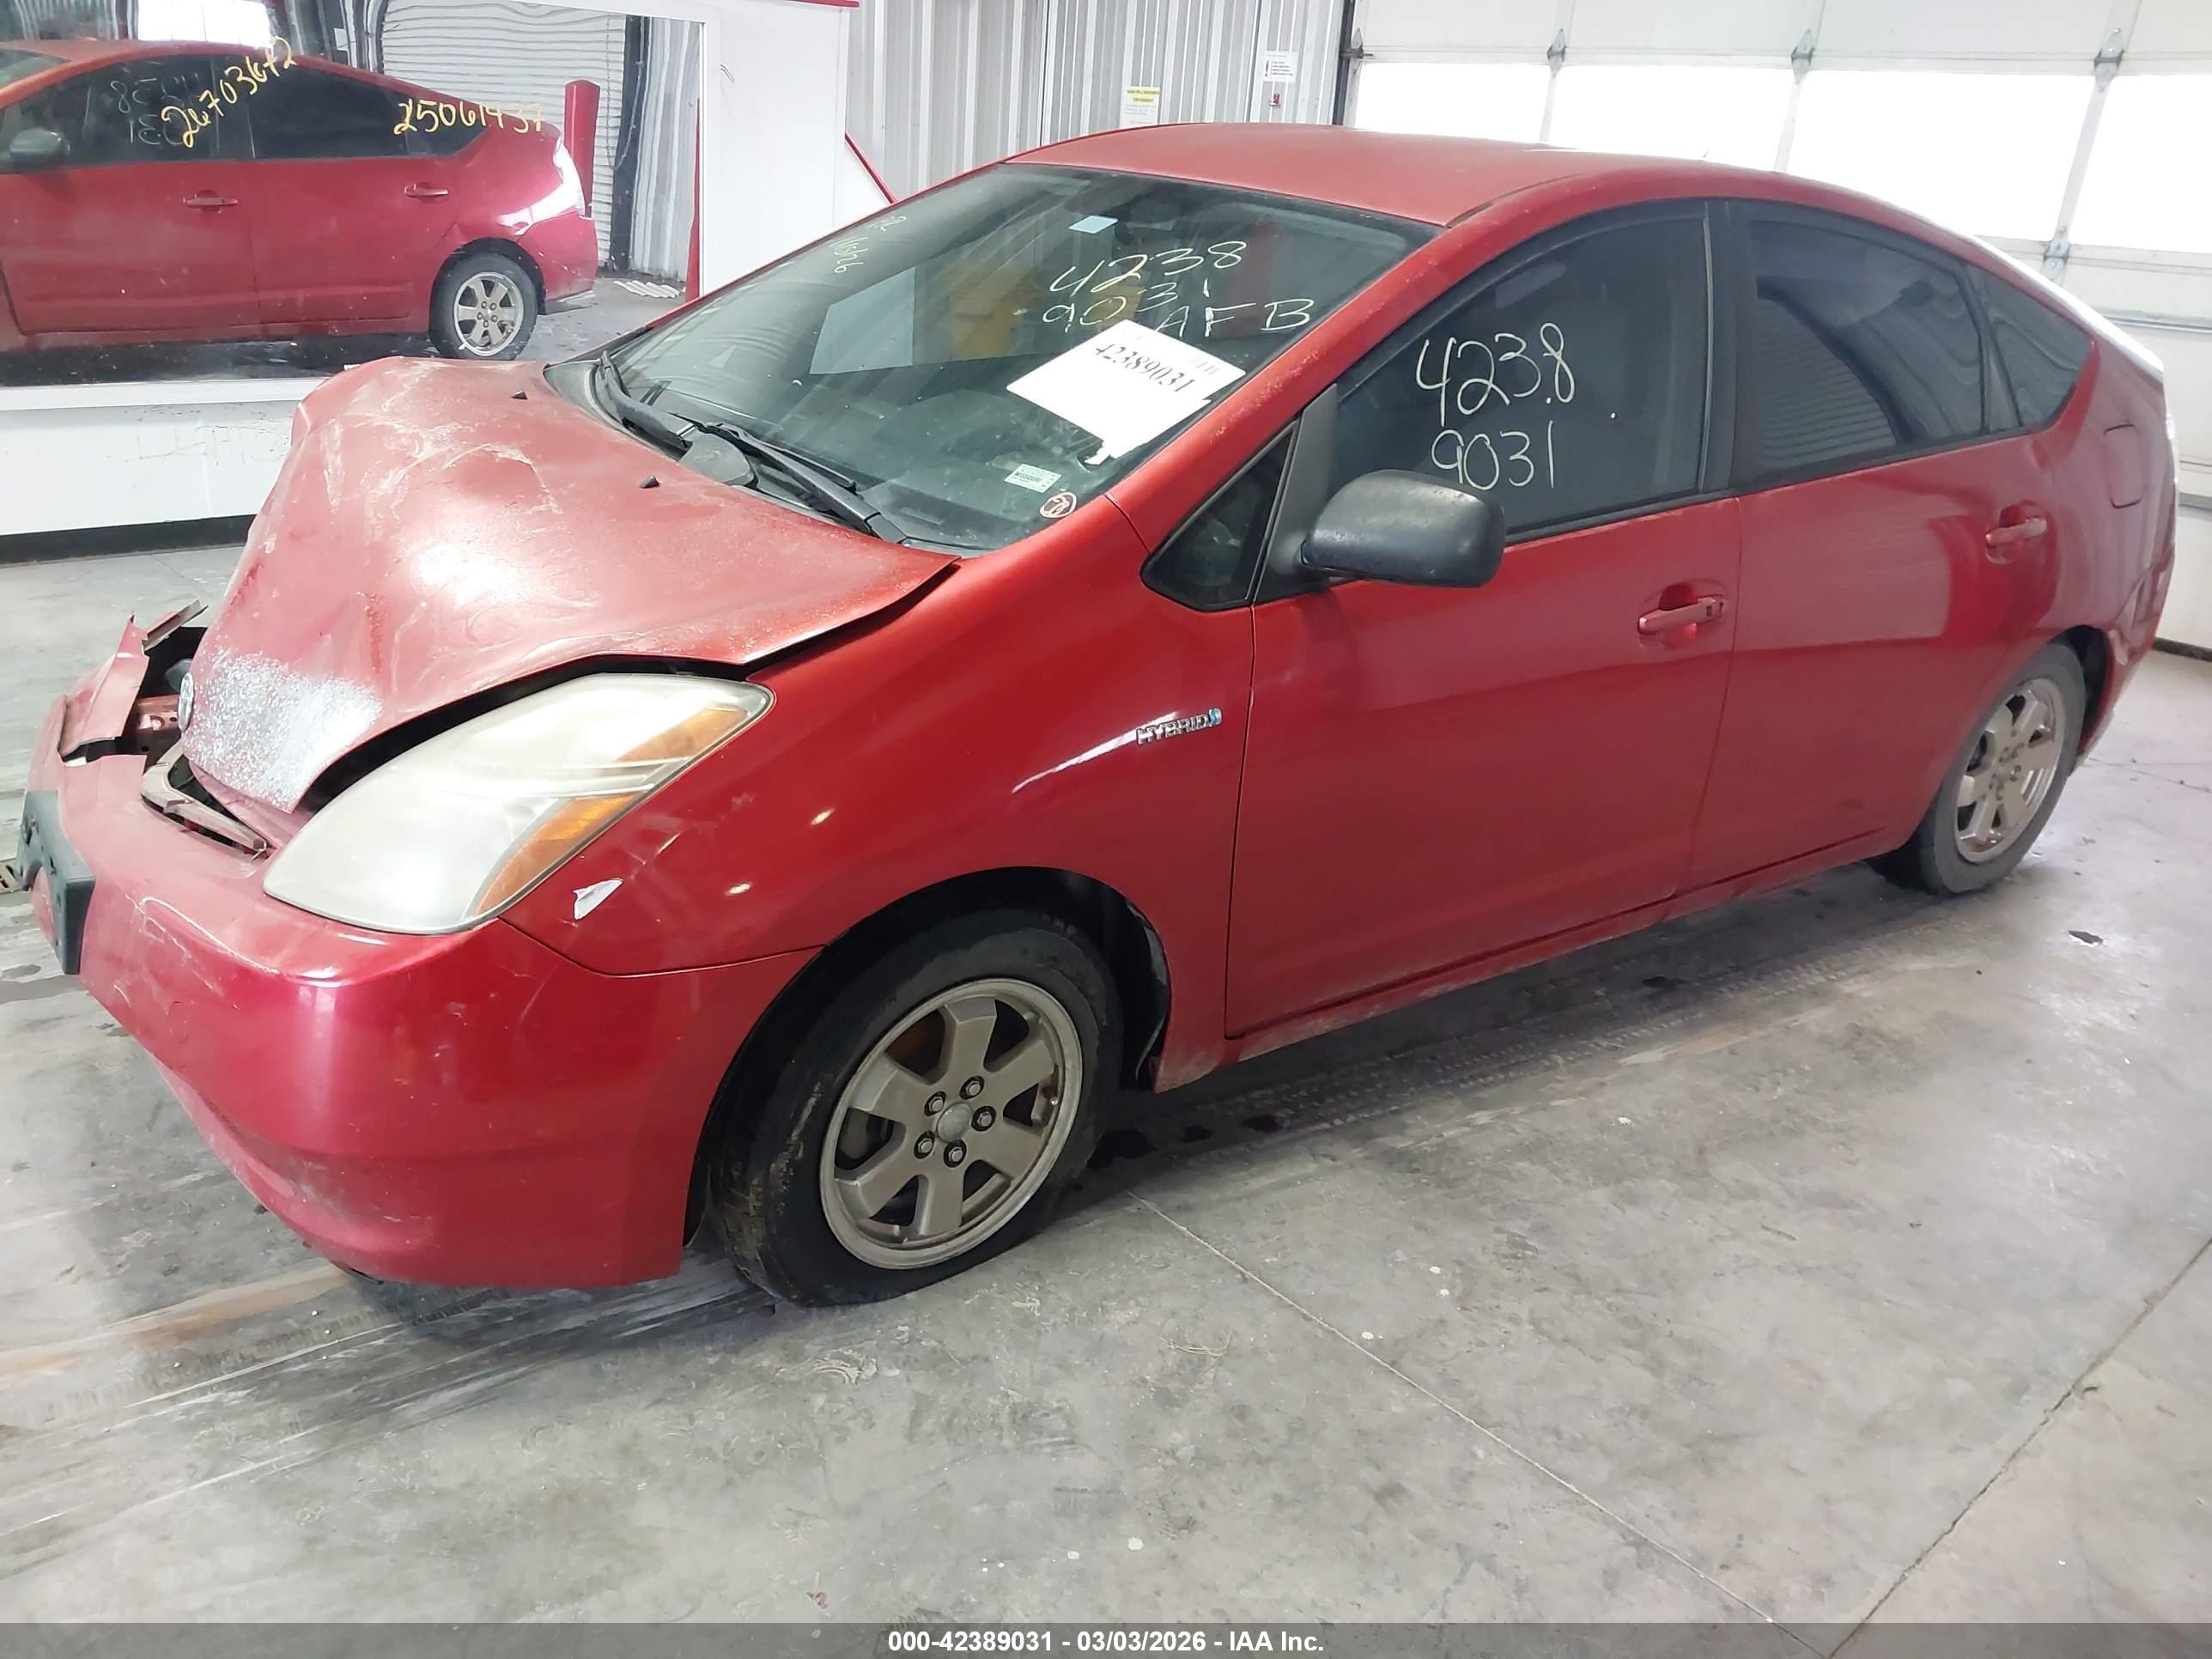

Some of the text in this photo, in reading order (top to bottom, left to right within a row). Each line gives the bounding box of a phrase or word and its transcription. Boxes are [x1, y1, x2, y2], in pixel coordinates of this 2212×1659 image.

[1049, 241, 1246, 296] 4238
[1042, 277, 1210, 333] 9031
[1416, 323, 1575, 428] 4238
[1431, 420, 1555, 490] 9031
[1137, 714, 1212, 745] HYBRID
